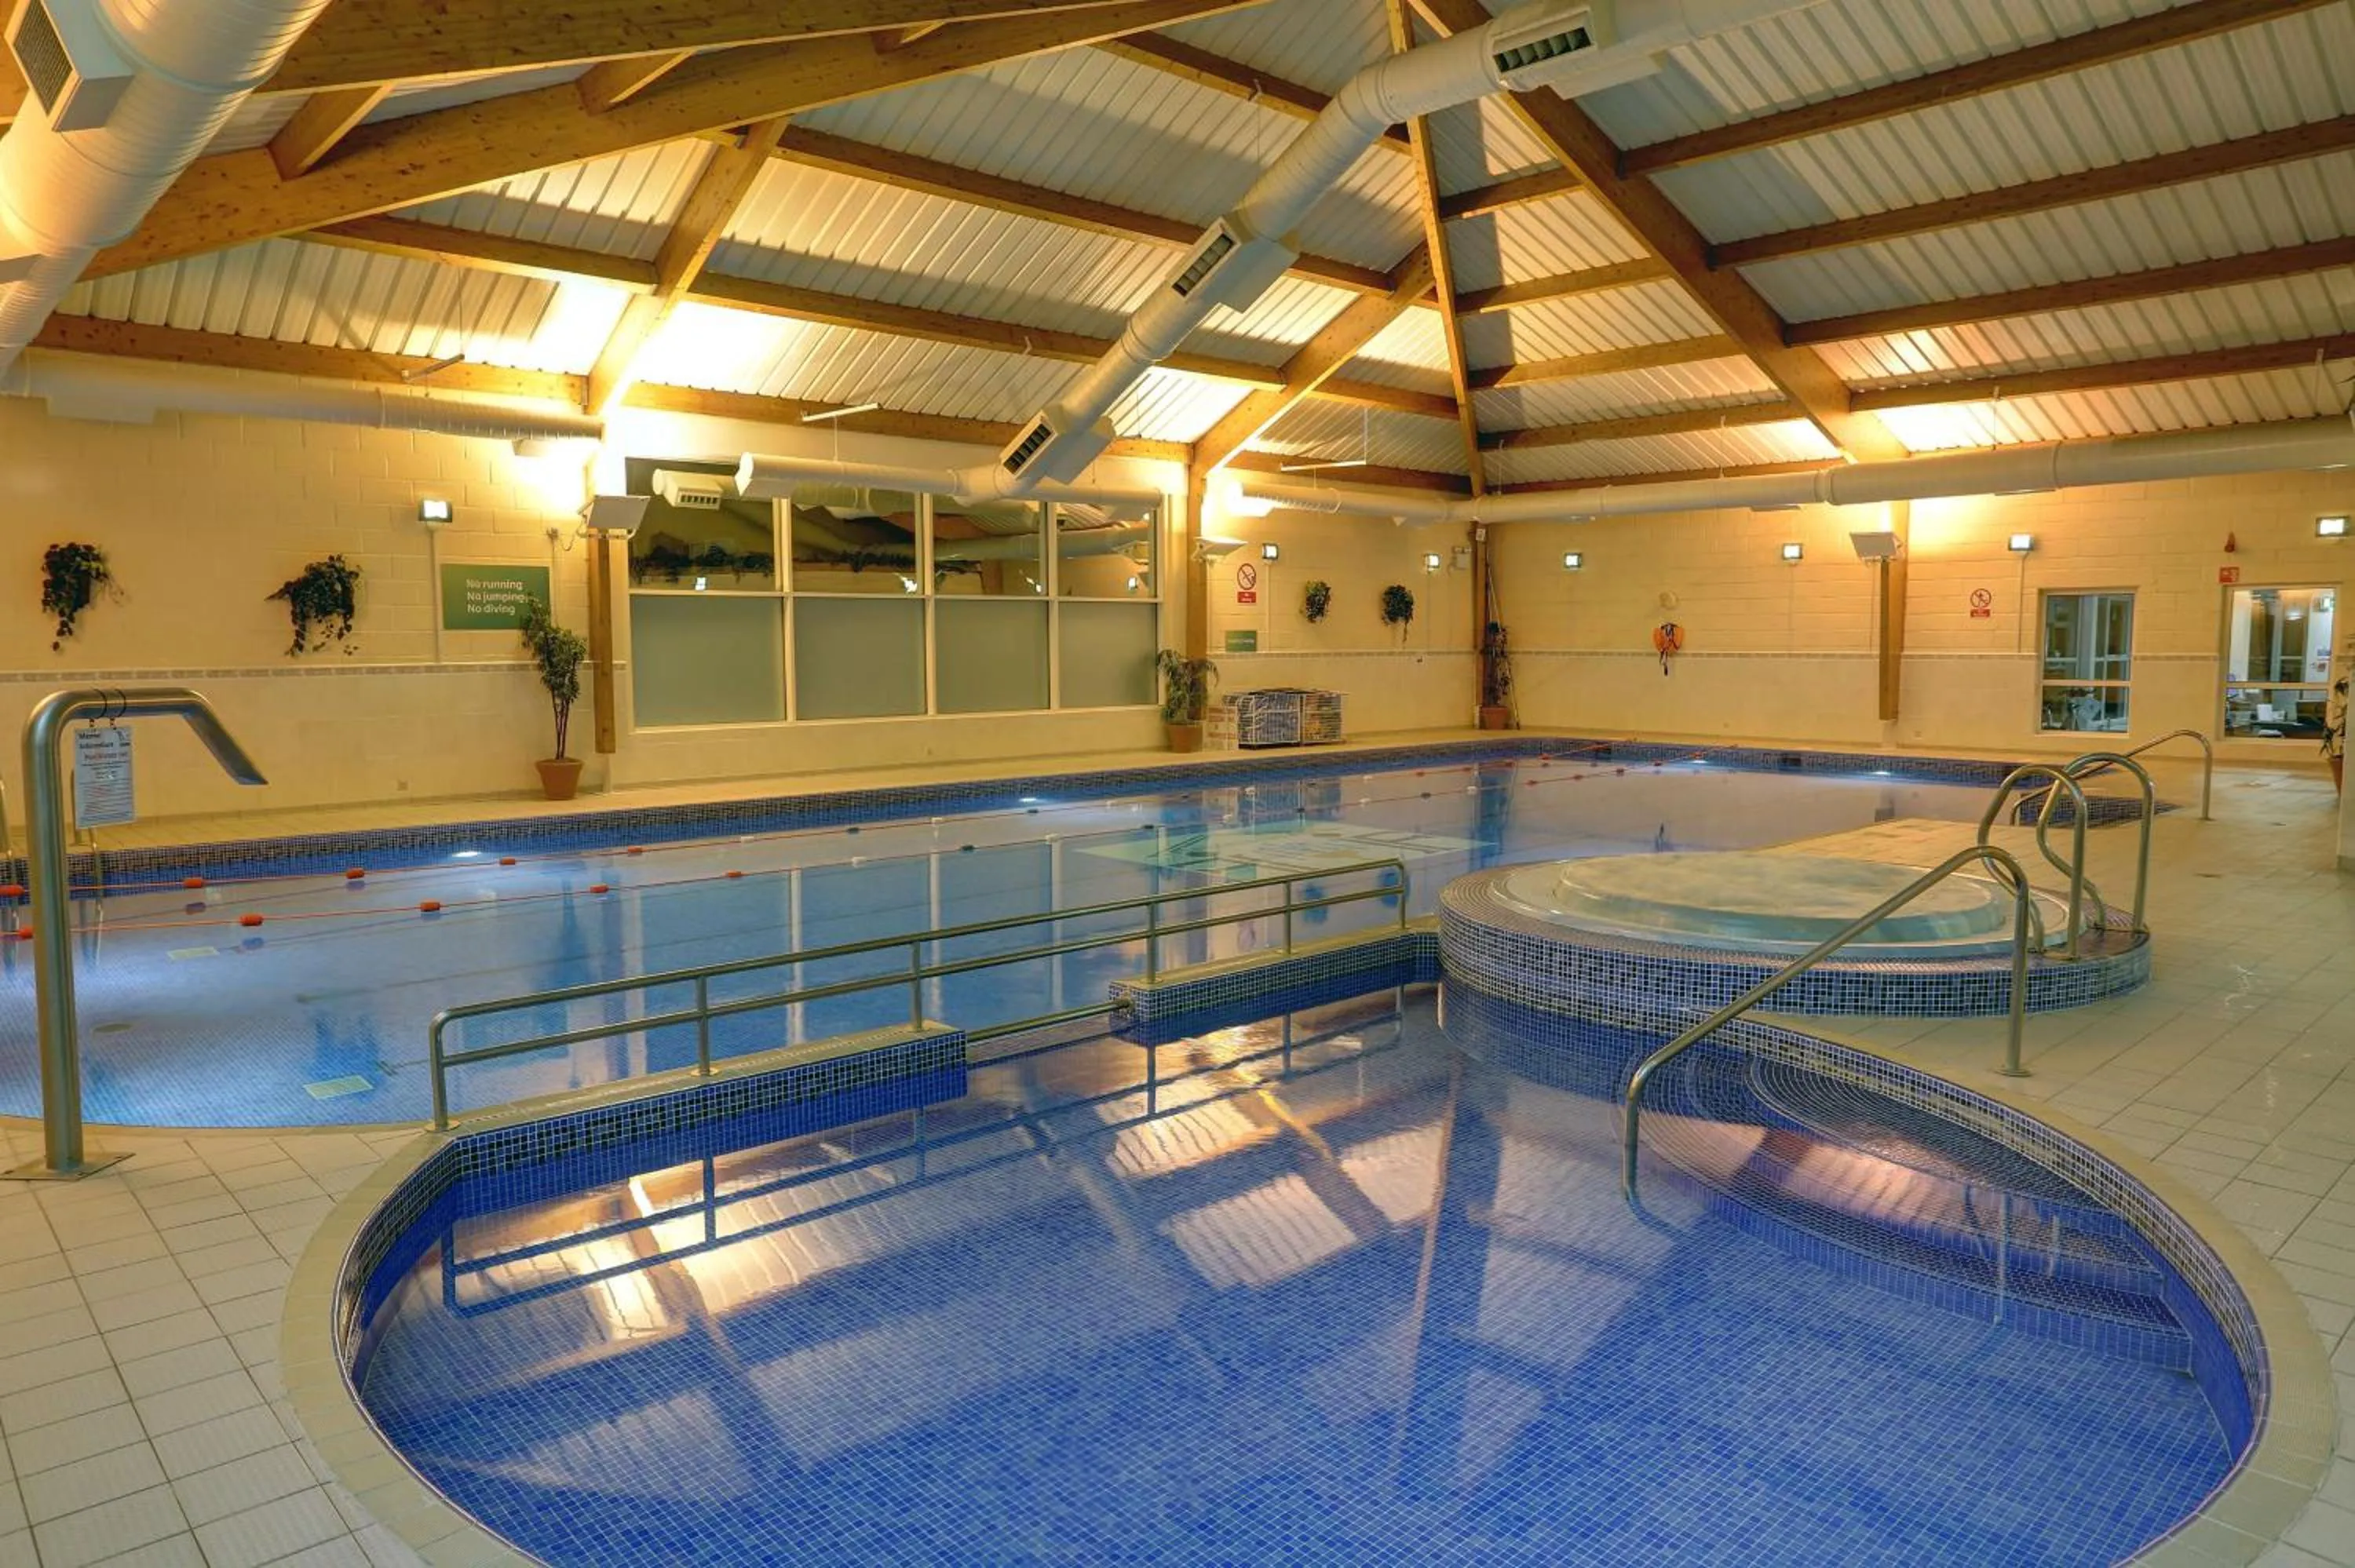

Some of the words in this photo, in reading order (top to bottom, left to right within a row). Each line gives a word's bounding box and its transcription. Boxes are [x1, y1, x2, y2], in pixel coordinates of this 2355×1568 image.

[466, 579, 480, 588] No
[483, 579, 523, 590] running
[467, 592, 481, 600] No
[483, 592, 524, 603] jumping
[467, 604, 481, 613] No
[484, 604, 515, 615] diving
